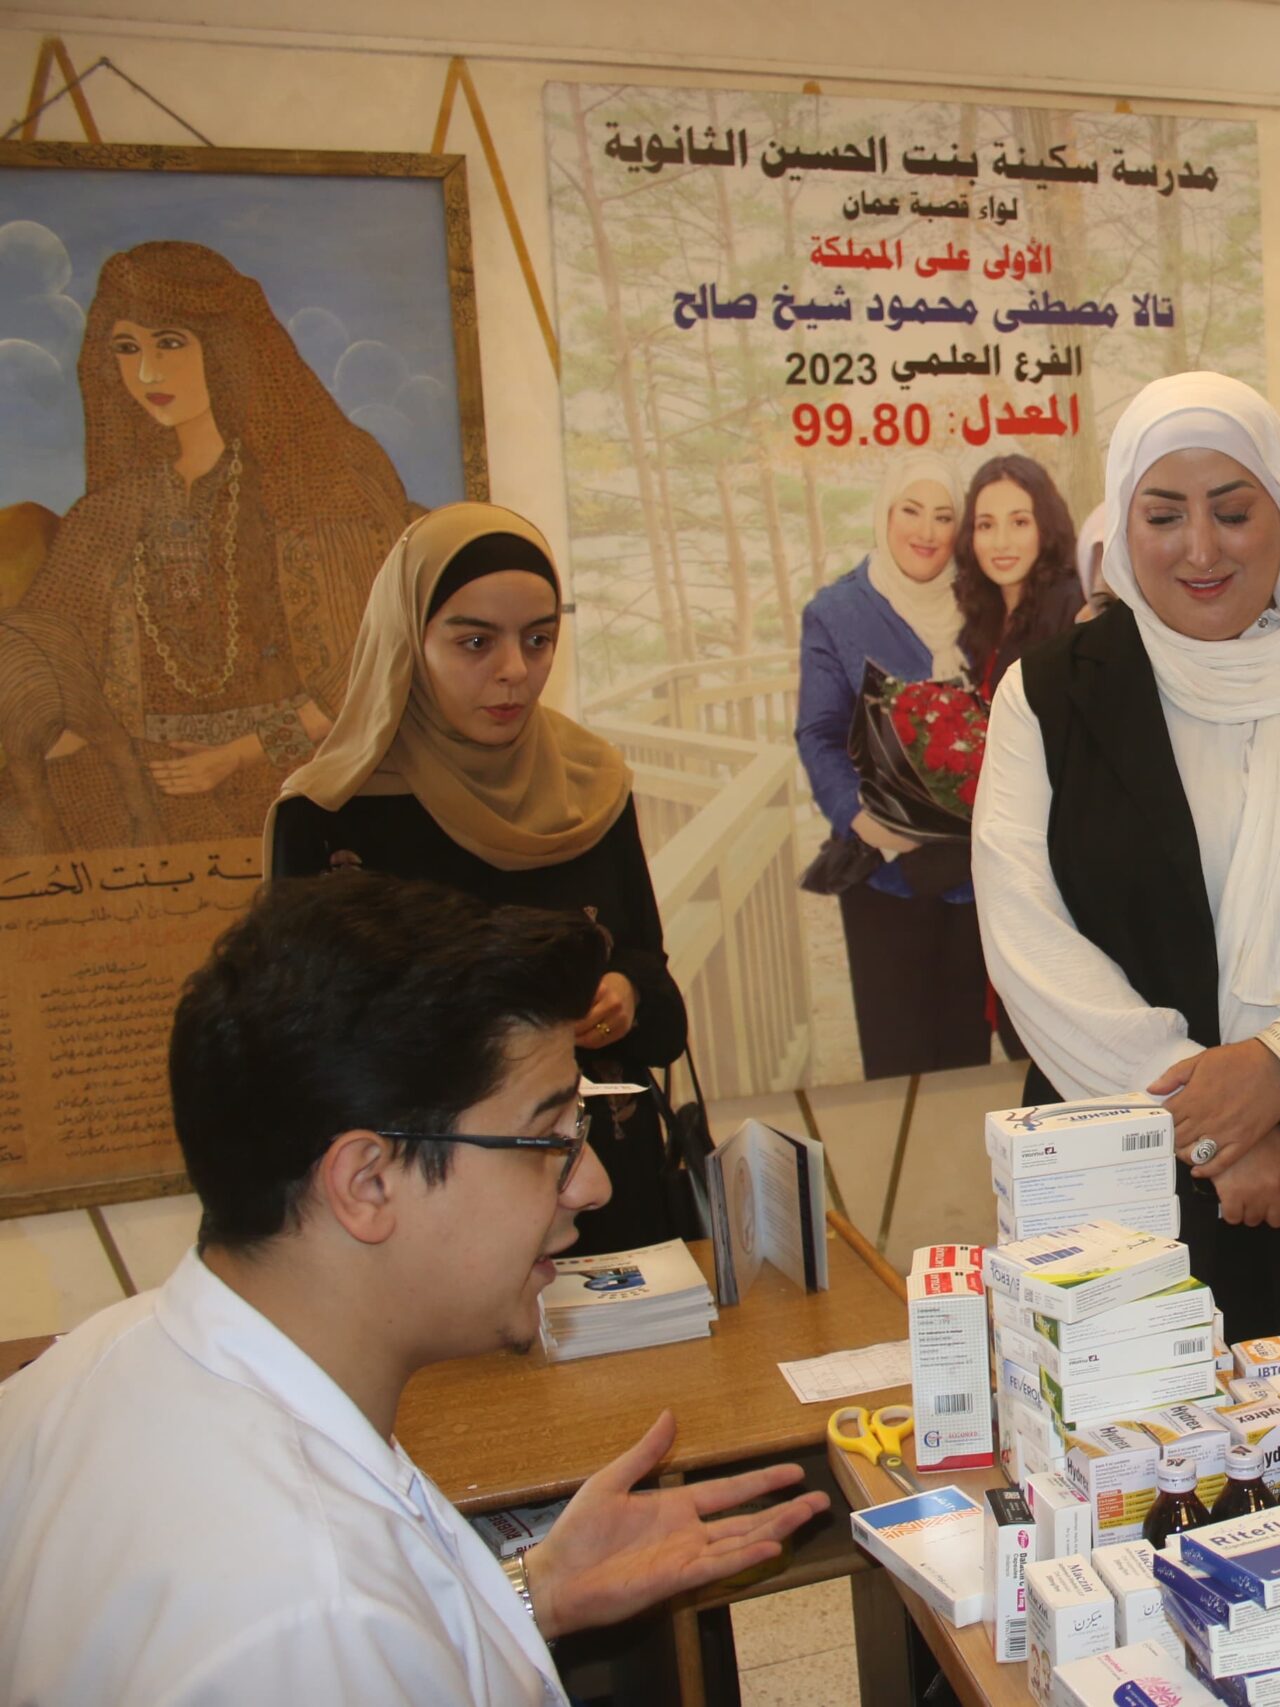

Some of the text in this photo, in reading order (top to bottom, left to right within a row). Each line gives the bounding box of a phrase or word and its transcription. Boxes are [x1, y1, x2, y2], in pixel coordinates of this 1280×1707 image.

[604, 121, 1219, 197] مدرسة سكينة بنت الحسين الثانوية
[842, 190, 1018, 226] لواء قصبة عمان
[810, 236, 1052, 281] الأولى على المملكة
[673, 282, 1175, 333] تالا مصطفى محمود شيخ صالح
[785, 344, 1082, 391] الفرع العلمي 2023
[791, 402, 931, 447] 99.80
[1099, 1426, 1133, 1451] Hydrex
[1170, 1405, 1203, 1431] Hydrex
